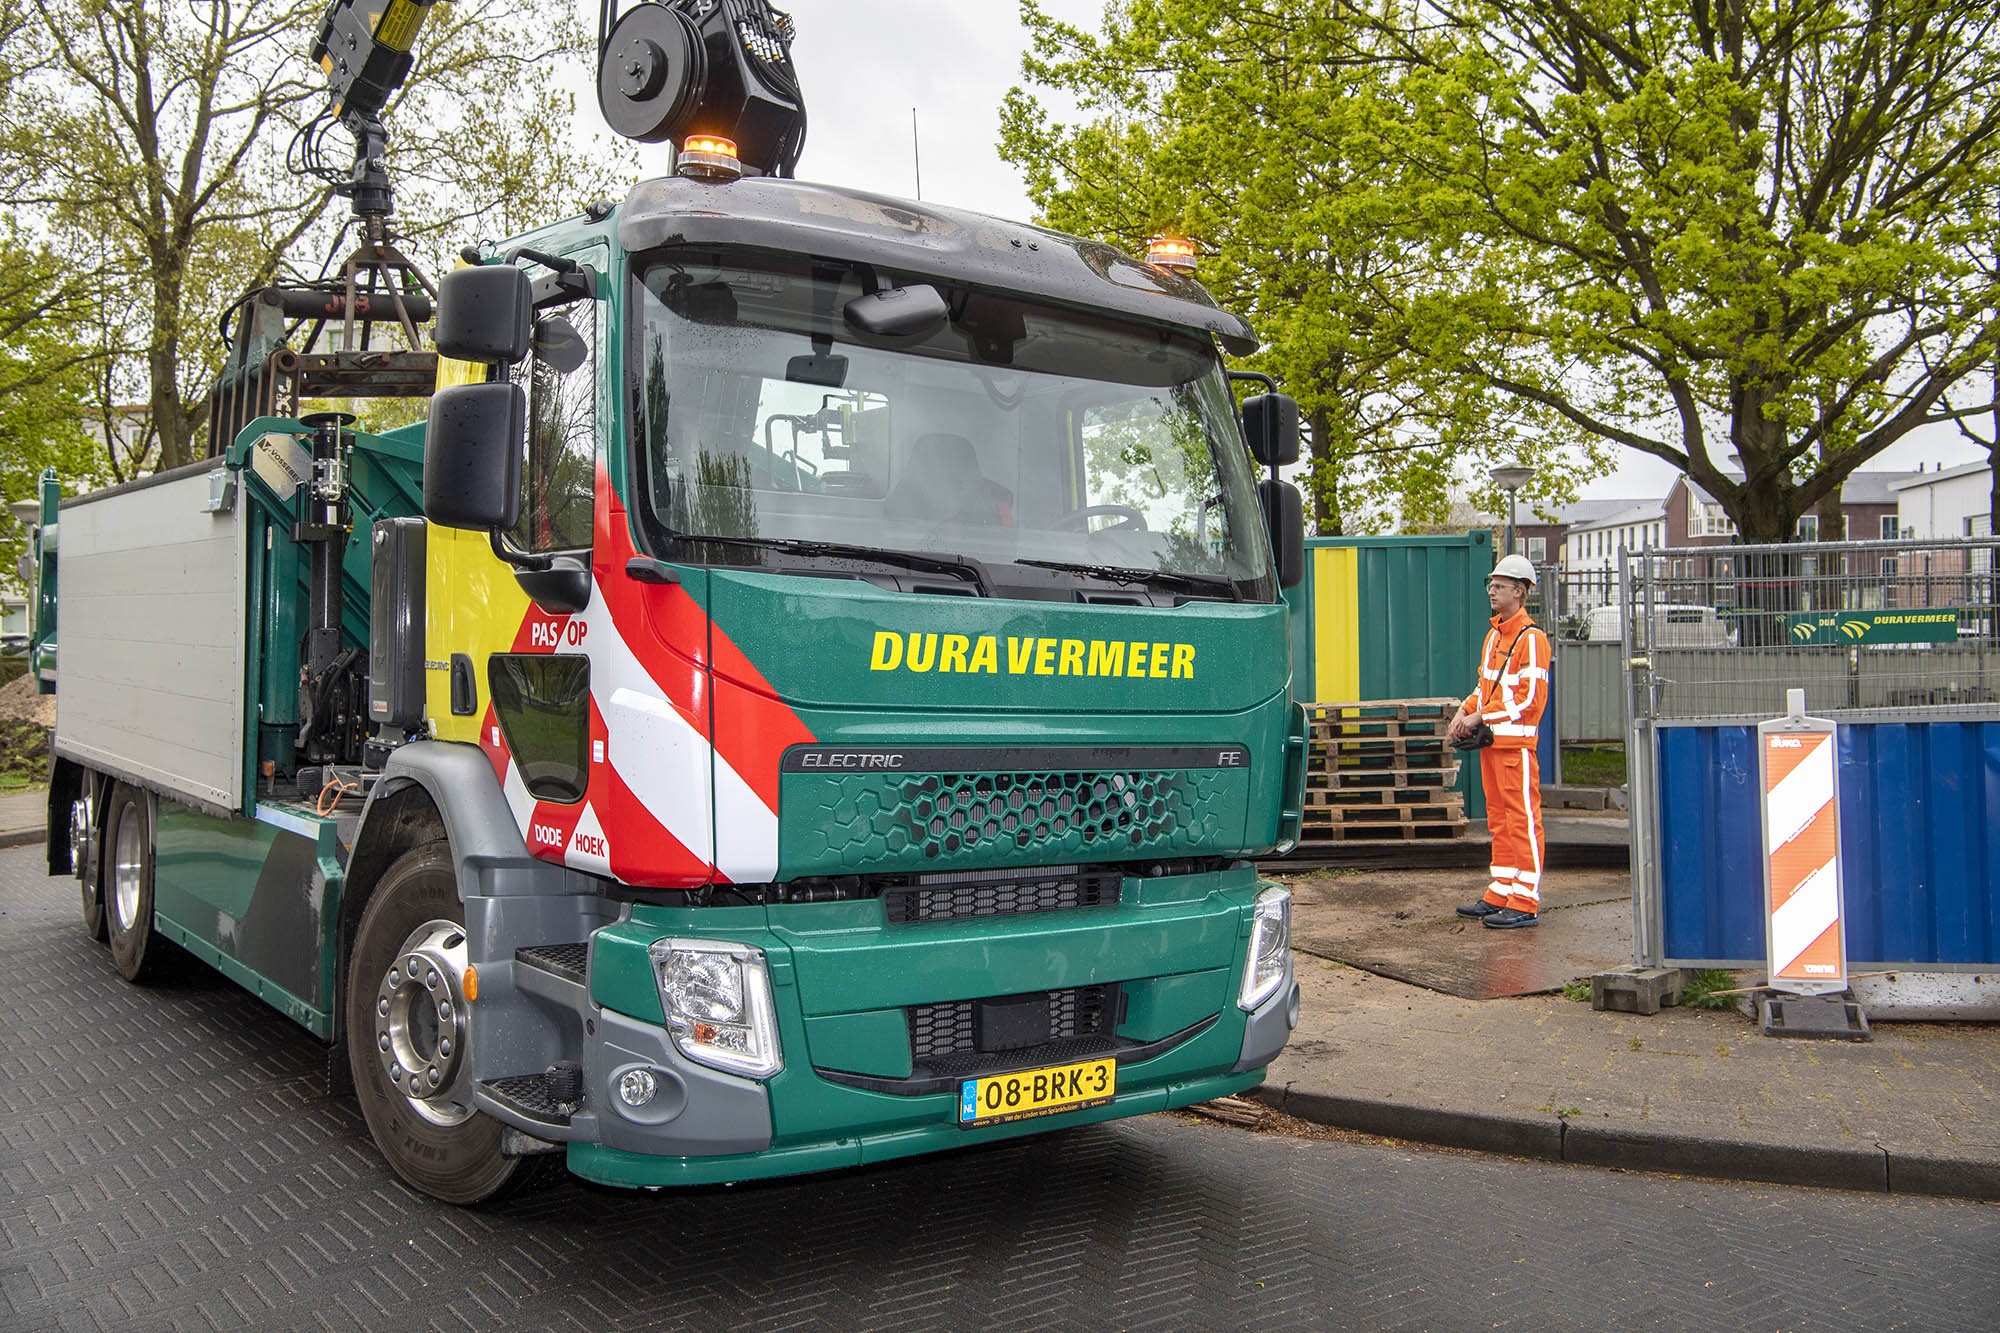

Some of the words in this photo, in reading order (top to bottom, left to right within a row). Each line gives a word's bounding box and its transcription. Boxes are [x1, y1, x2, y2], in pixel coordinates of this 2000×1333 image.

[1873, 615, 1901, 625] DURA
[1903, 614, 1956, 624] VERMEER
[531, 622, 558, 646] PAS
[567, 620, 588, 646] OP
[870, 631, 998, 674] DURA
[1007, 636, 1196, 679] VERMEER
[802, 753, 904, 768] ELECTRIC
[1217, 751, 1241, 765] FE
[534, 823, 563, 847] DODE
[575, 832, 605, 857] HOEK
[985, 1065, 1107, 1110] 08-BRK-3
[963, 1103, 975, 1113] NL
